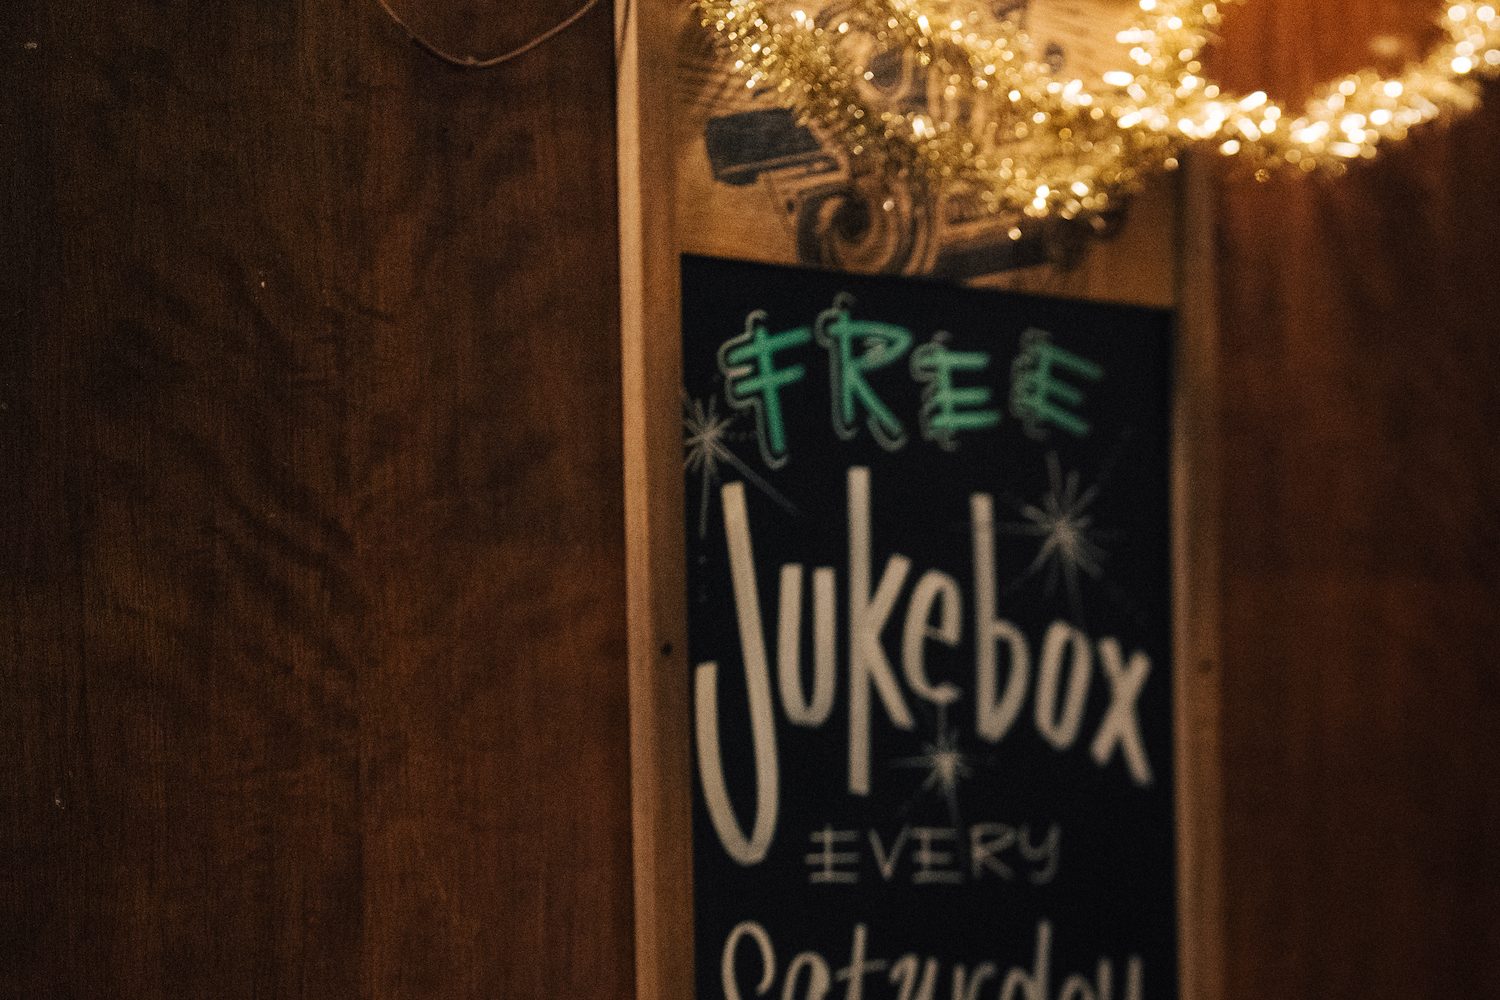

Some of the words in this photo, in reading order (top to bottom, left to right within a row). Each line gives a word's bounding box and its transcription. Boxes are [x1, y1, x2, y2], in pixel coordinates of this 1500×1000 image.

[717, 291, 1103, 470] FREE
[694, 464, 1155, 868] Jukebox
[804, 821, 1062, 886] EVERY
